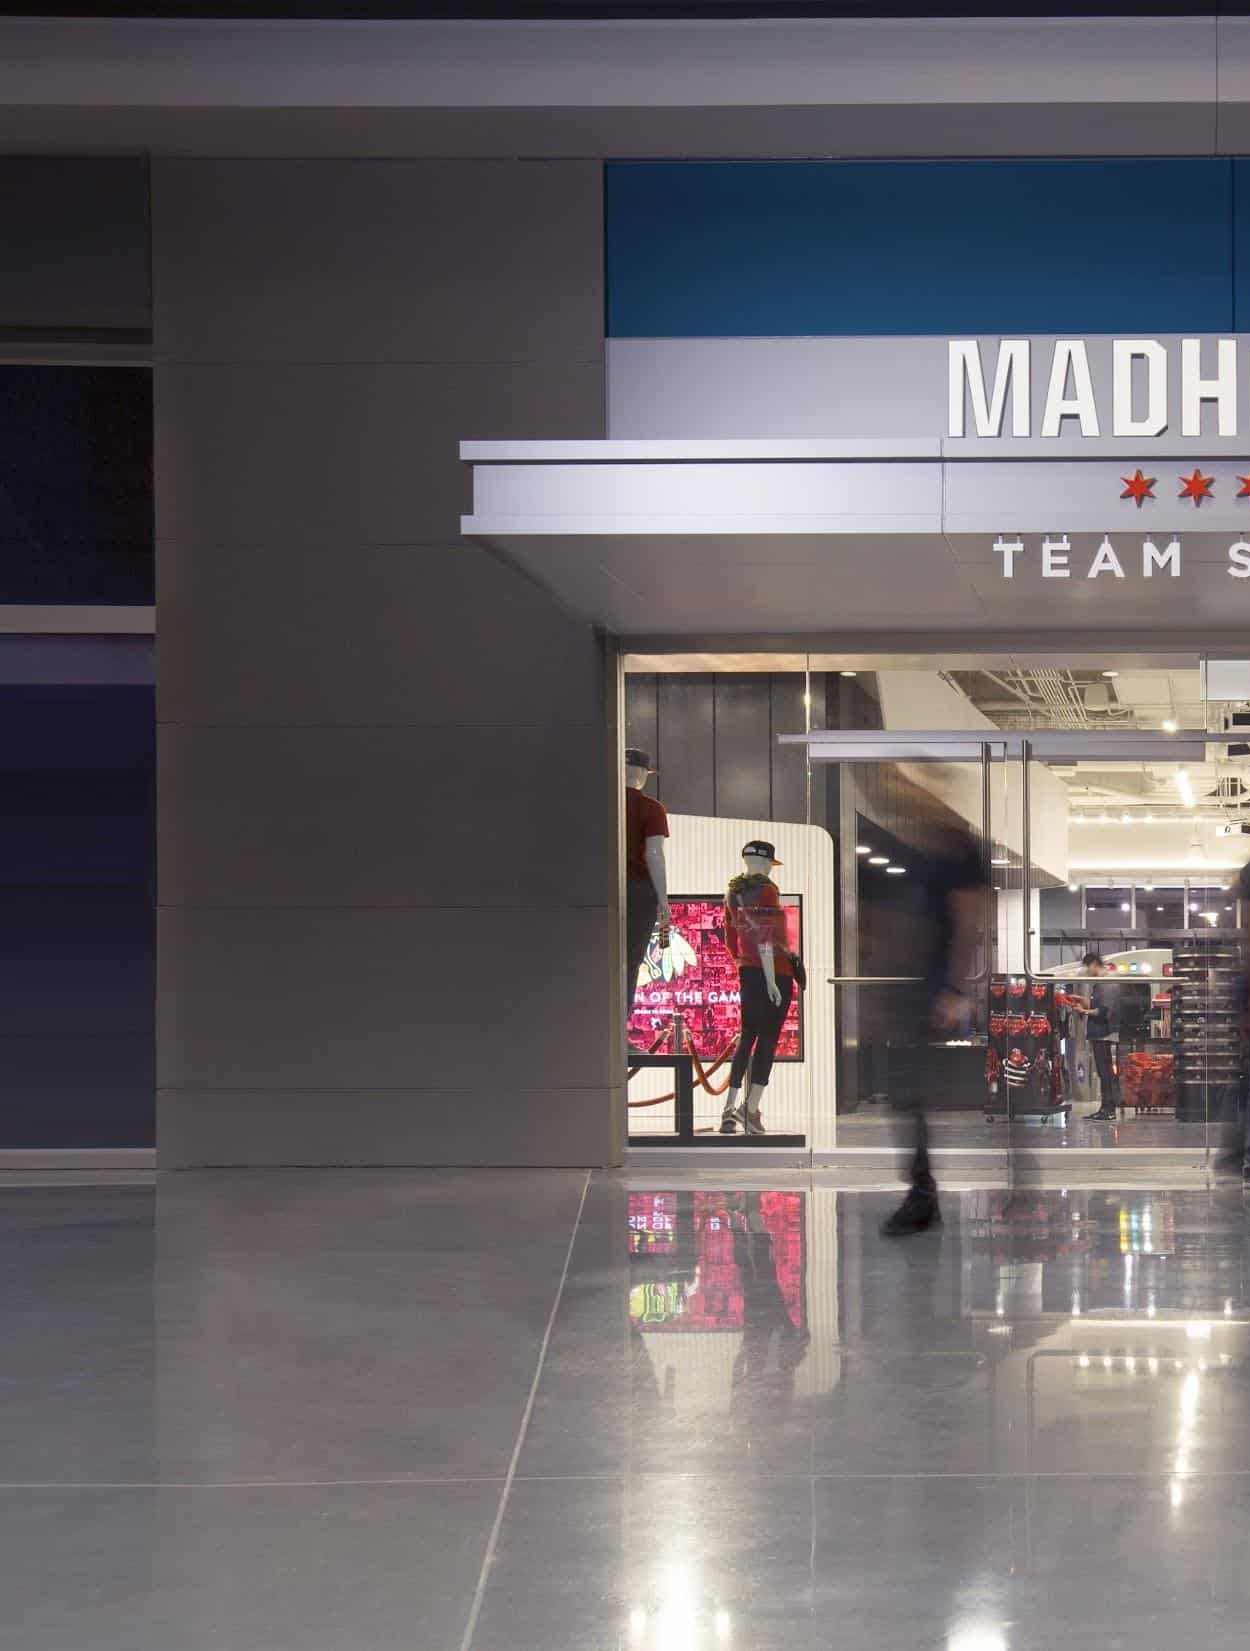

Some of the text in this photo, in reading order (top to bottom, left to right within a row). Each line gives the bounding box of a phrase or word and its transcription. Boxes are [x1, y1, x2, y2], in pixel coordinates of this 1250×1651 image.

[993, 542, 1182, 578] TEAM
[650, 991, 673, 1003] OF
[675, 991, 703, 1004] THE
[708, 991, 741, 1003] GAM
